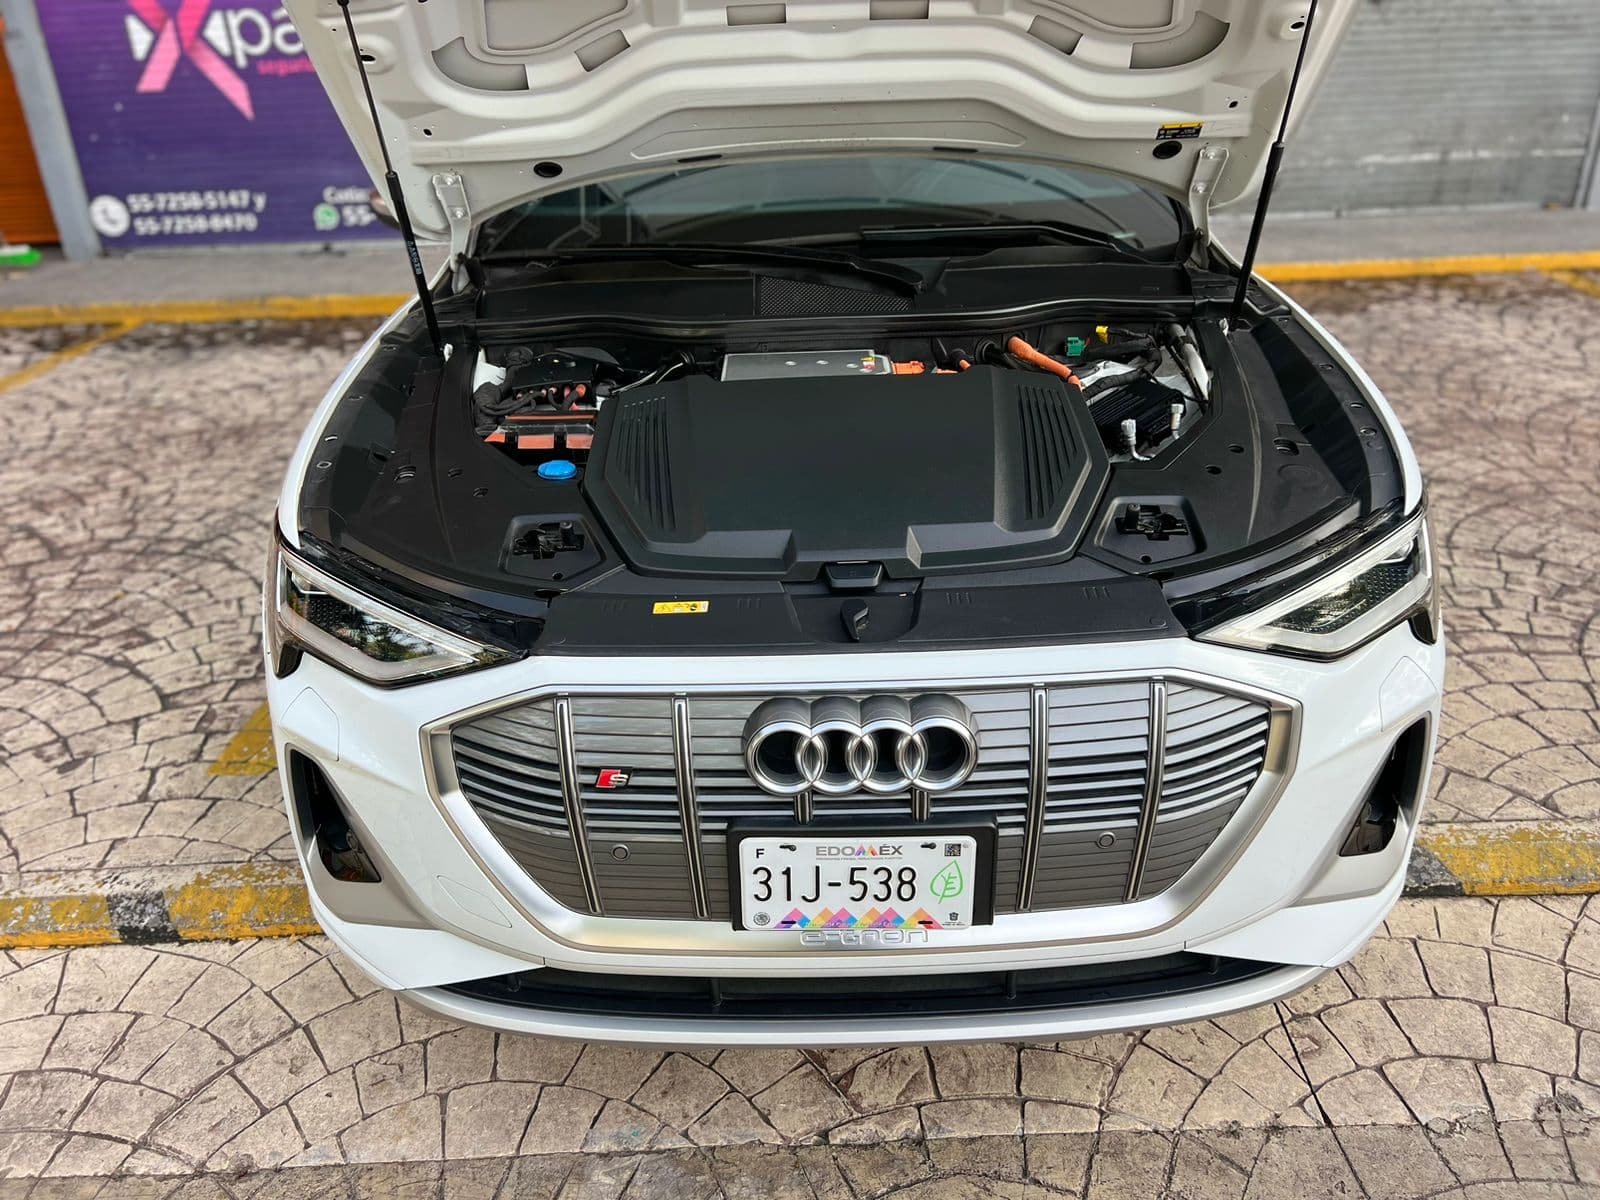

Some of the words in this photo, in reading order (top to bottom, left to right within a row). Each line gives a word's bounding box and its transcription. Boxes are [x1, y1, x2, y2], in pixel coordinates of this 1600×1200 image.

[252, 191, 267, 213] y
[756, 848, 765, 859] F
[752, 865, 917, 903] 31J-538
